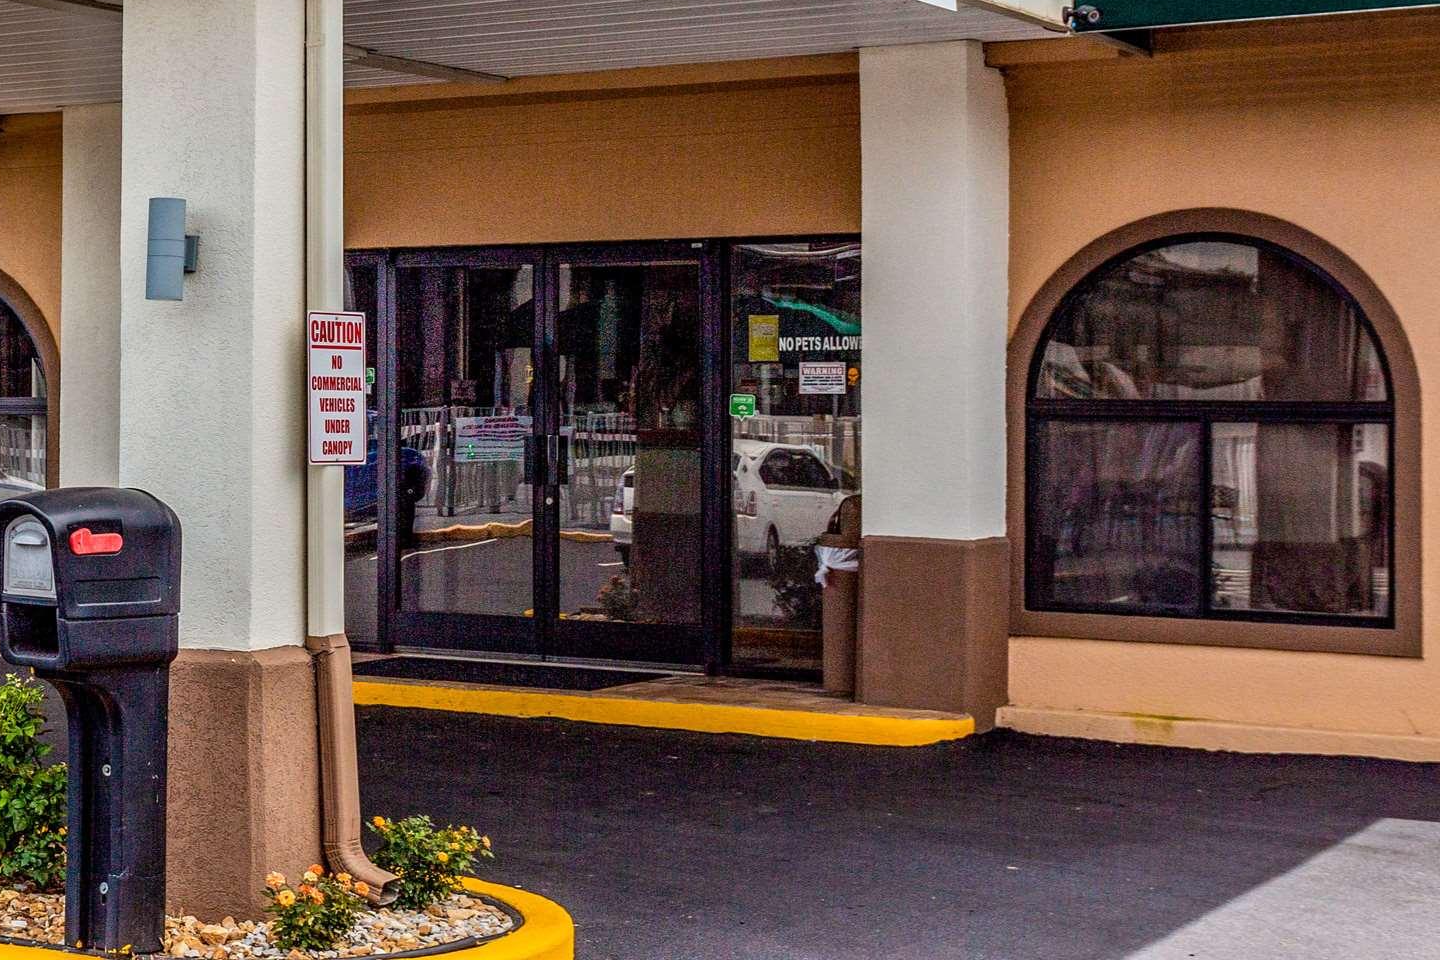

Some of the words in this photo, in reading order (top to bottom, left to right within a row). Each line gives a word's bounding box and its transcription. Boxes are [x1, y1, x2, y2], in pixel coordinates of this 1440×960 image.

[311, 320, 362, 344] CAUTION
[778, 336, 794, 352] NO
[795, 336, 822, 351] PETS
[331, 355, 343, 370] NO
[802, 367, 843, 375] WARNING
[311, 376, 362, 391] COMMERCIAL
[319, 397, 356, 413] VEHICLES
[324, 419, 351, 434] UNDER
[322, 440, 353, 455] CANOPY
